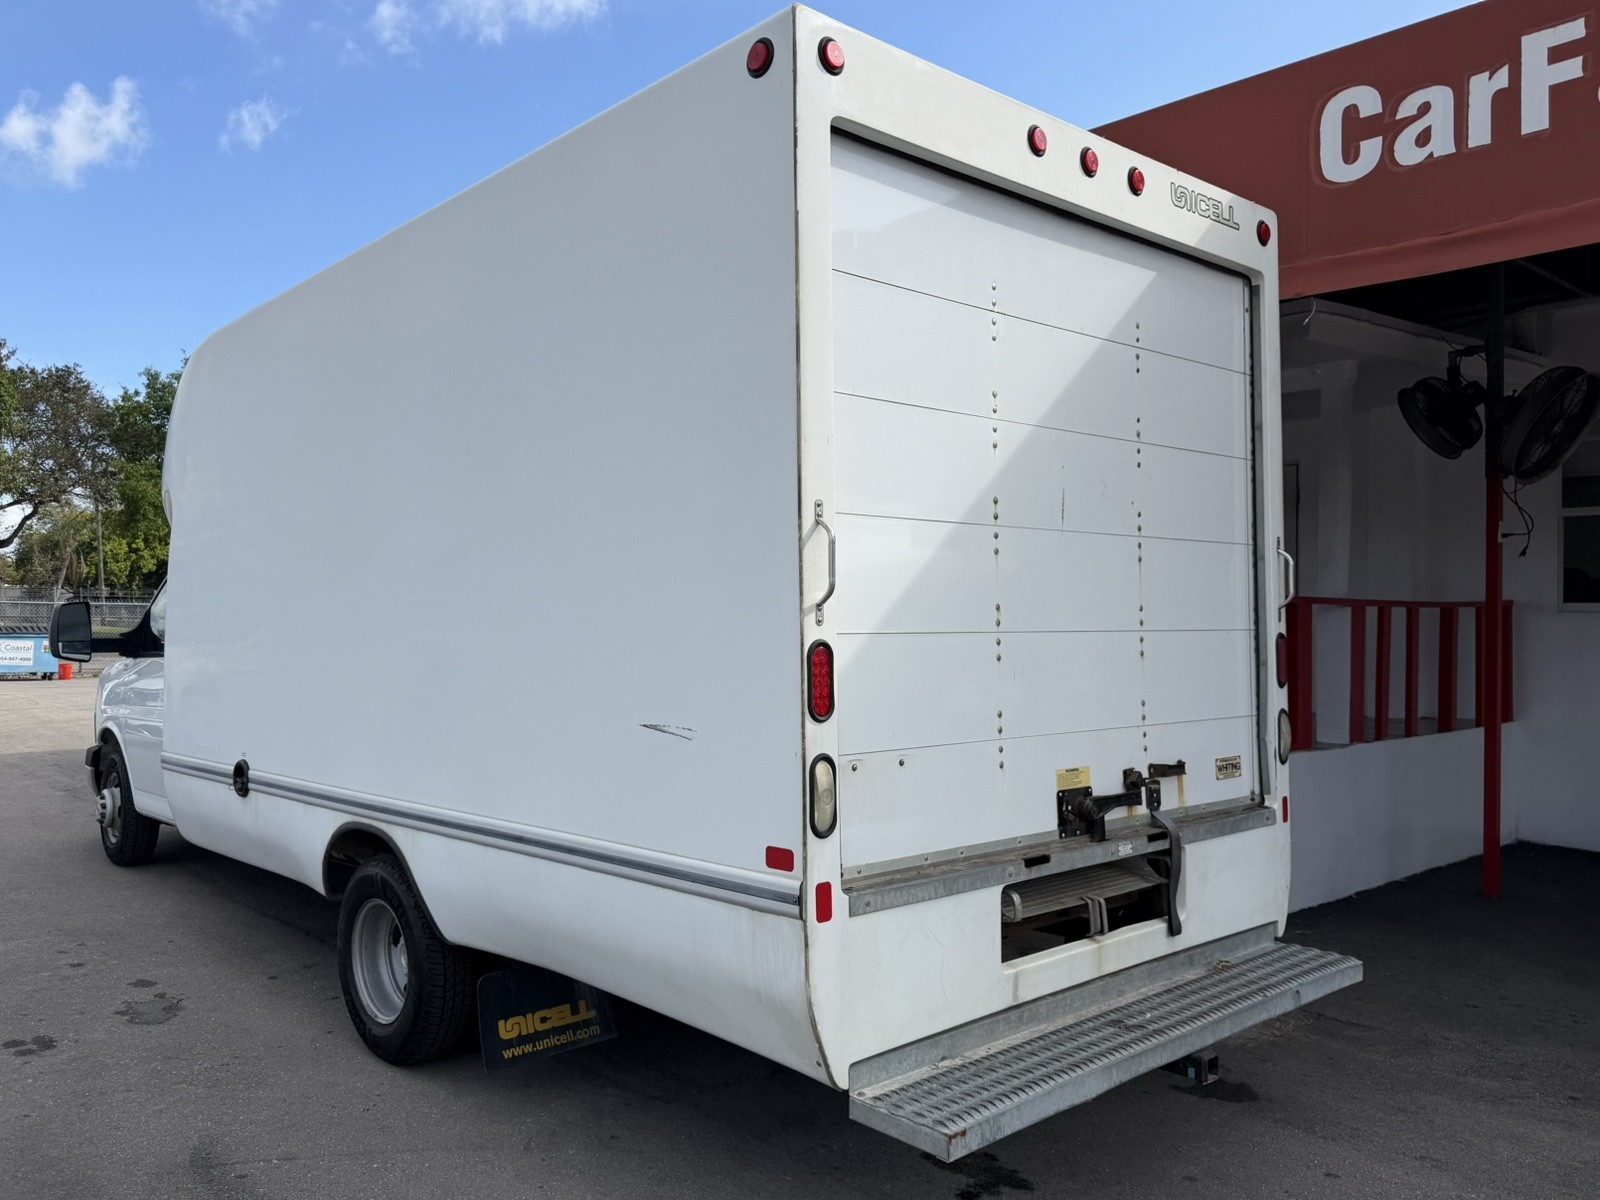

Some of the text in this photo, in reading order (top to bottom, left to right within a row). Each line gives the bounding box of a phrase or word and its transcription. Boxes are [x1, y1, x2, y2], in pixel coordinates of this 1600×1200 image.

[1319, 17, 1600, 183] CarF
[1170, 181, 1240, 231] UNICELL
[4, 644, 32, 652] Coastal
[497, 999, 597, 1040] UNICELL
[502, 1025, 600, 1059] www.unicell.com
